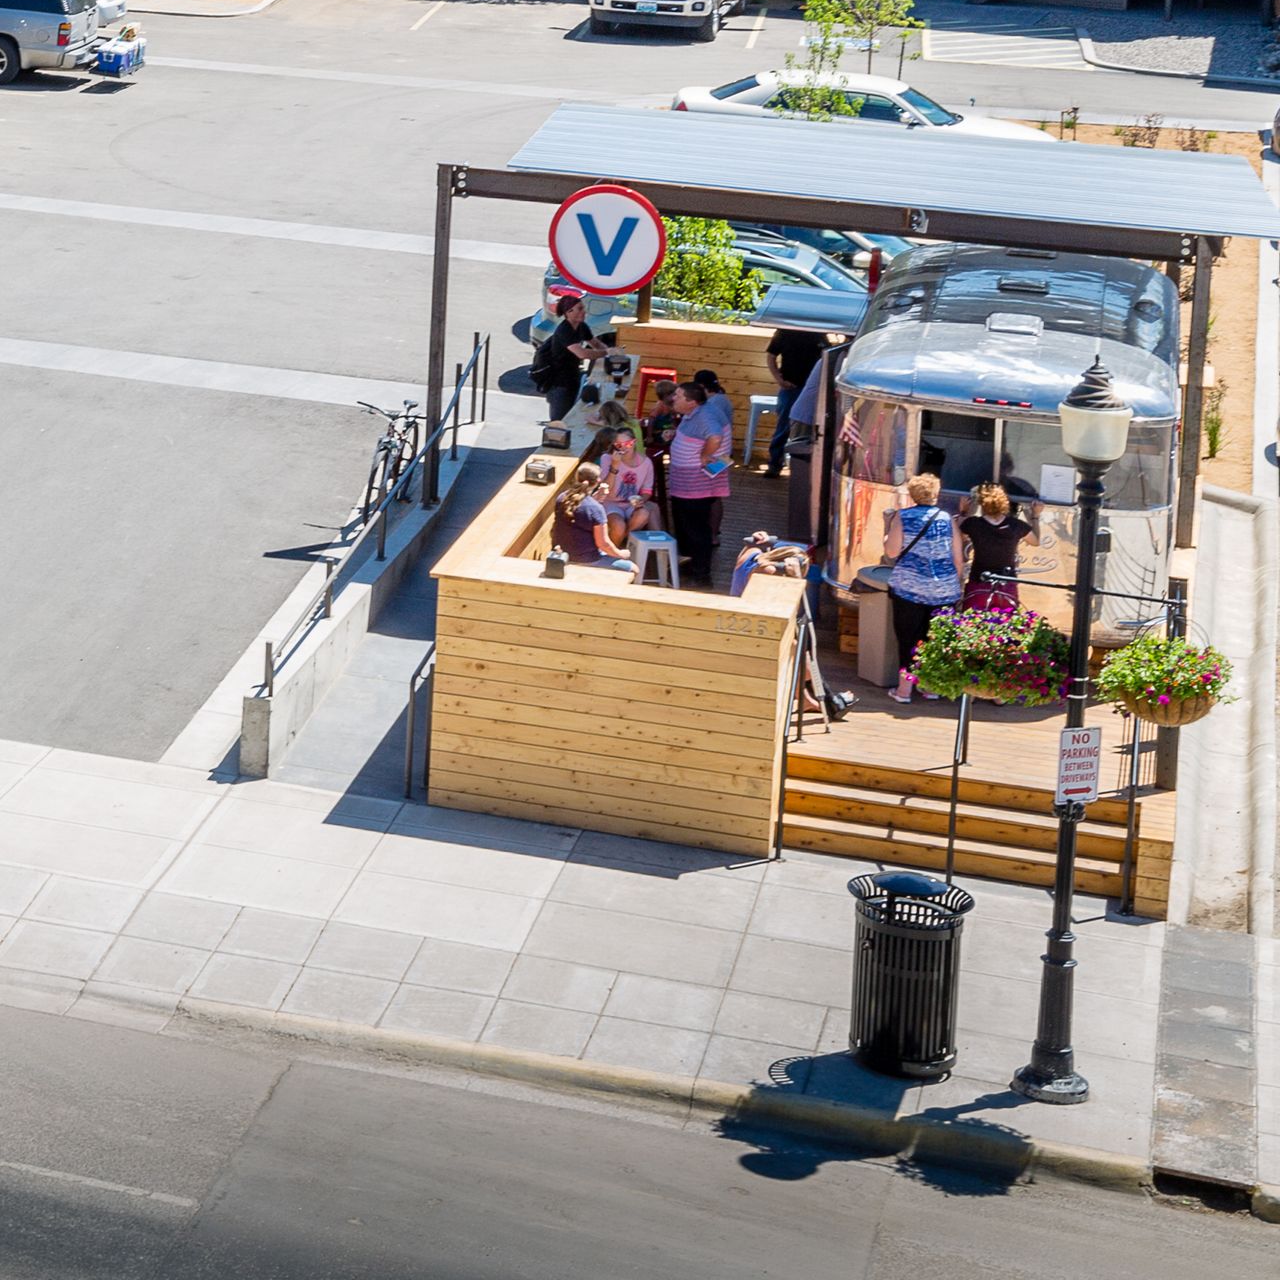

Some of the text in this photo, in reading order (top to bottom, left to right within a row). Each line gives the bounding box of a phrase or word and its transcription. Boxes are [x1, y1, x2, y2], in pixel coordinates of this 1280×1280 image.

[576, 213, 640, 277] V
[1072, 733, 1090, 744] NO
[1061, 746, 1099, 760] PARKING
[1064, 761, 1094, 771] BETWEEN
[1061, 772, 1097, 784] DRIVEWAYS
